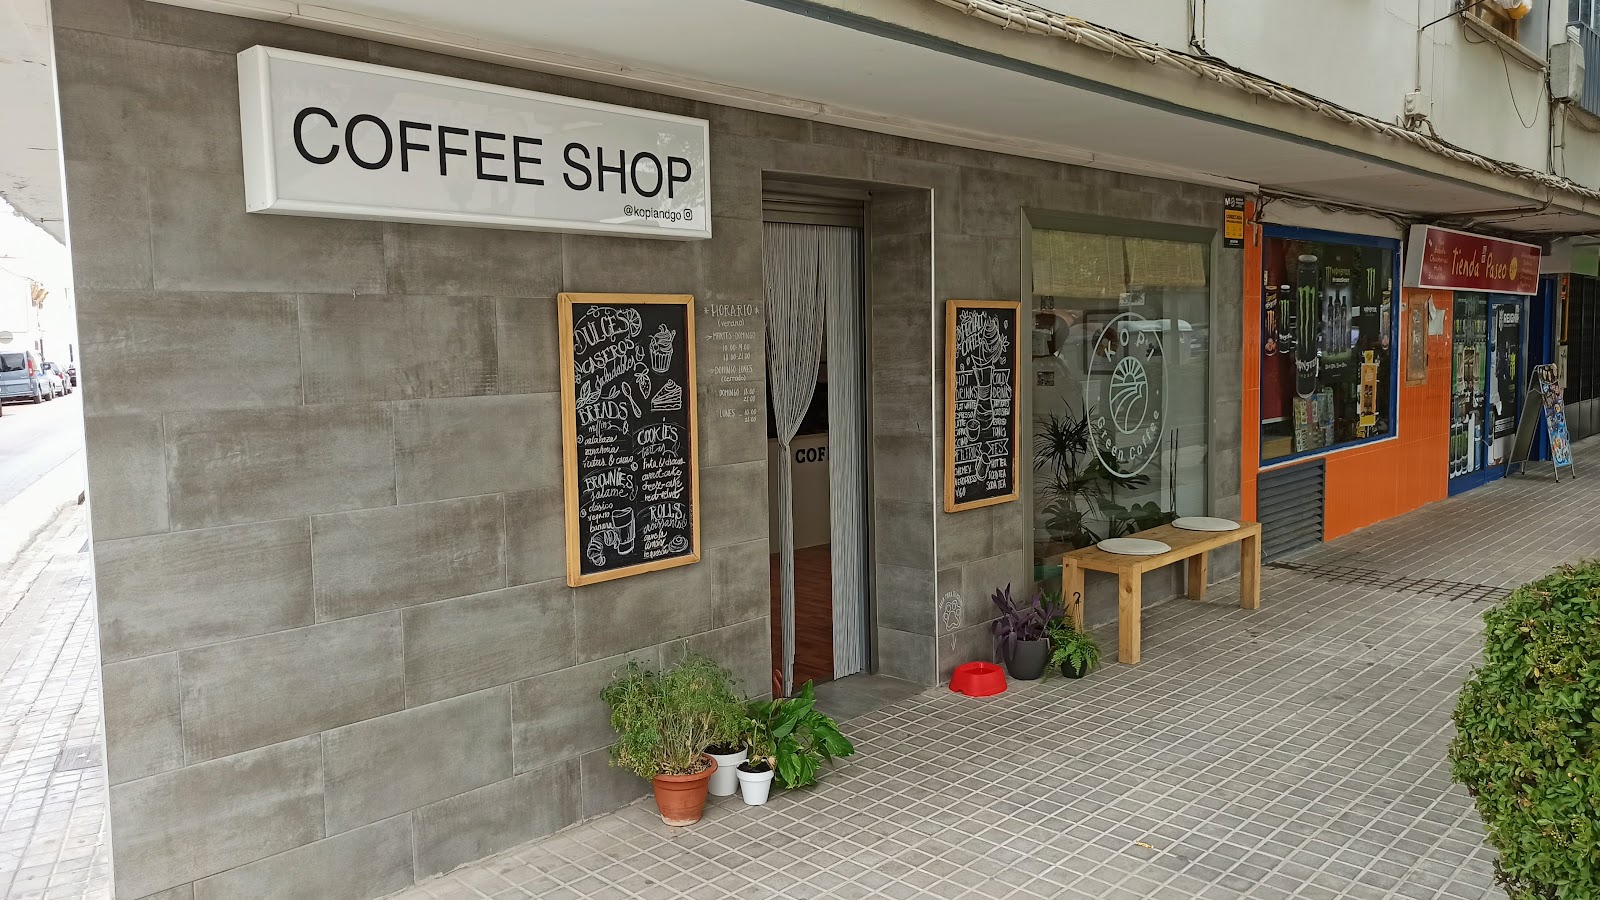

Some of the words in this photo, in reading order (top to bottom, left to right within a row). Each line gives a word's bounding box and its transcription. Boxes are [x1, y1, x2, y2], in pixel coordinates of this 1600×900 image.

[293, 106, 544, 186] COFFEE
[563, 142, 692, 199] SHOP
[623, 204, 682, 222] @kopiandgo
[1452, 247, 1480, 278] Tienda
[1485, 252, 1507, 280] Paseo
[711, 303, 753, 317] HORARIO
[574, 308, 631, 355] DULCES
[581, 337, 635, 374] CASEROS
[577, 401, 628, 426] BREADS
[637, 418, 679, 446] COOKIES
[1097, 415, 1124, 461] Green
[1129, 410, 1160, 461] Coffee
[795, 446, 829, 464] COF
[583, 468, 634, 493] BROWNIES
[649, 502, 683, 521] ROLLS
